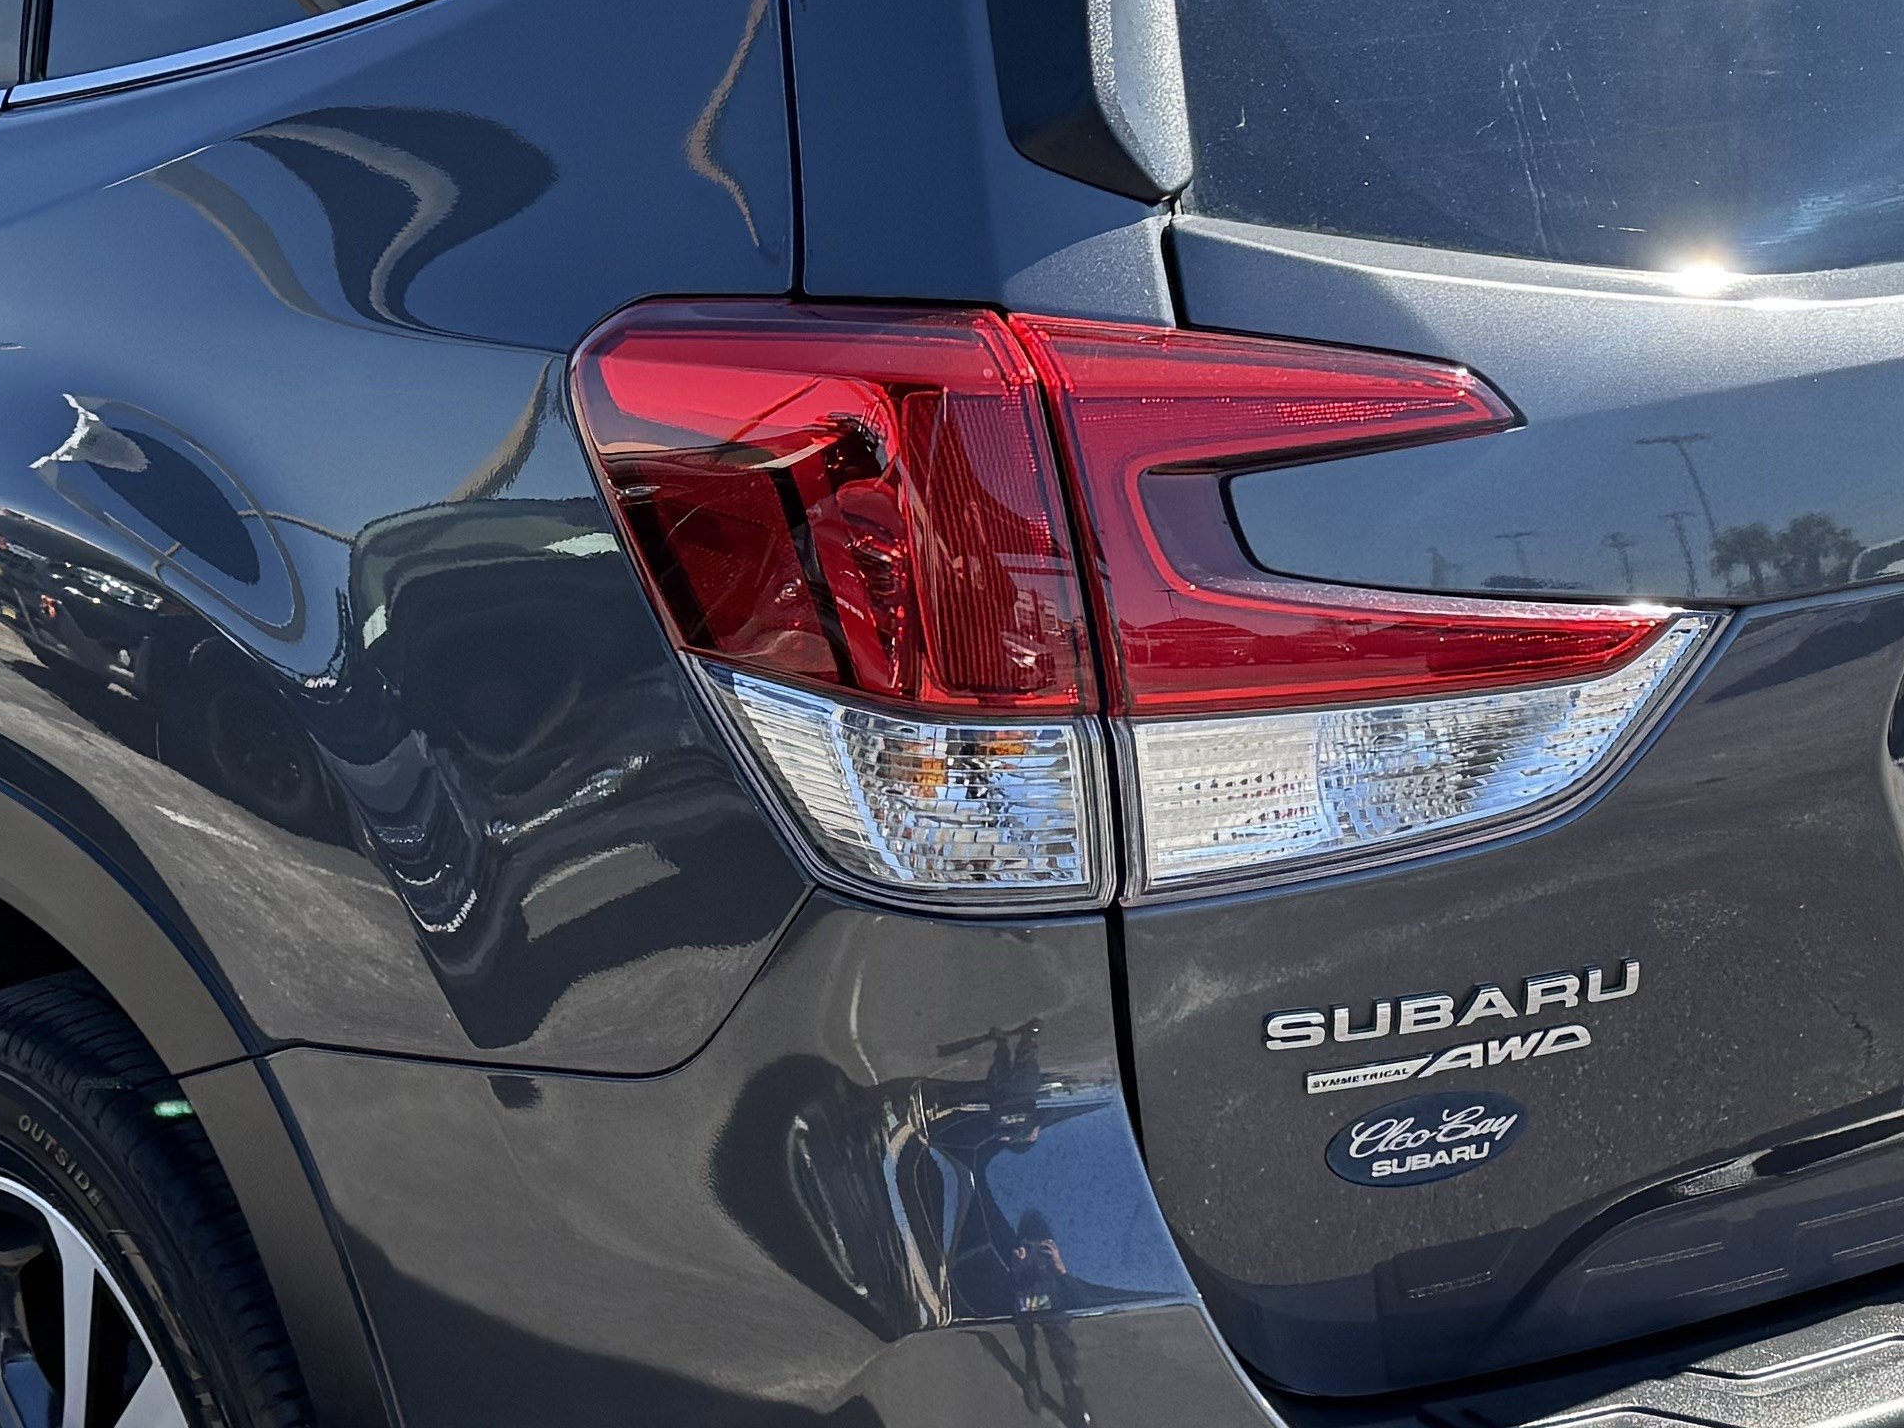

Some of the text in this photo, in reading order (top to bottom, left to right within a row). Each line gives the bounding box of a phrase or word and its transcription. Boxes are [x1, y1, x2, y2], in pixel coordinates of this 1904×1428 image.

[1264, 958, 1640, 1051] SUBARU
[1311, 1024, 1592, 1089] SYMMETRICAL AWD
[17, 1113, 104, 1208] OUTSIDE
[1349, 1105, 1518, 1159] Cleo Bay
[1371, 1142, 1490, 1178] SUBARU
